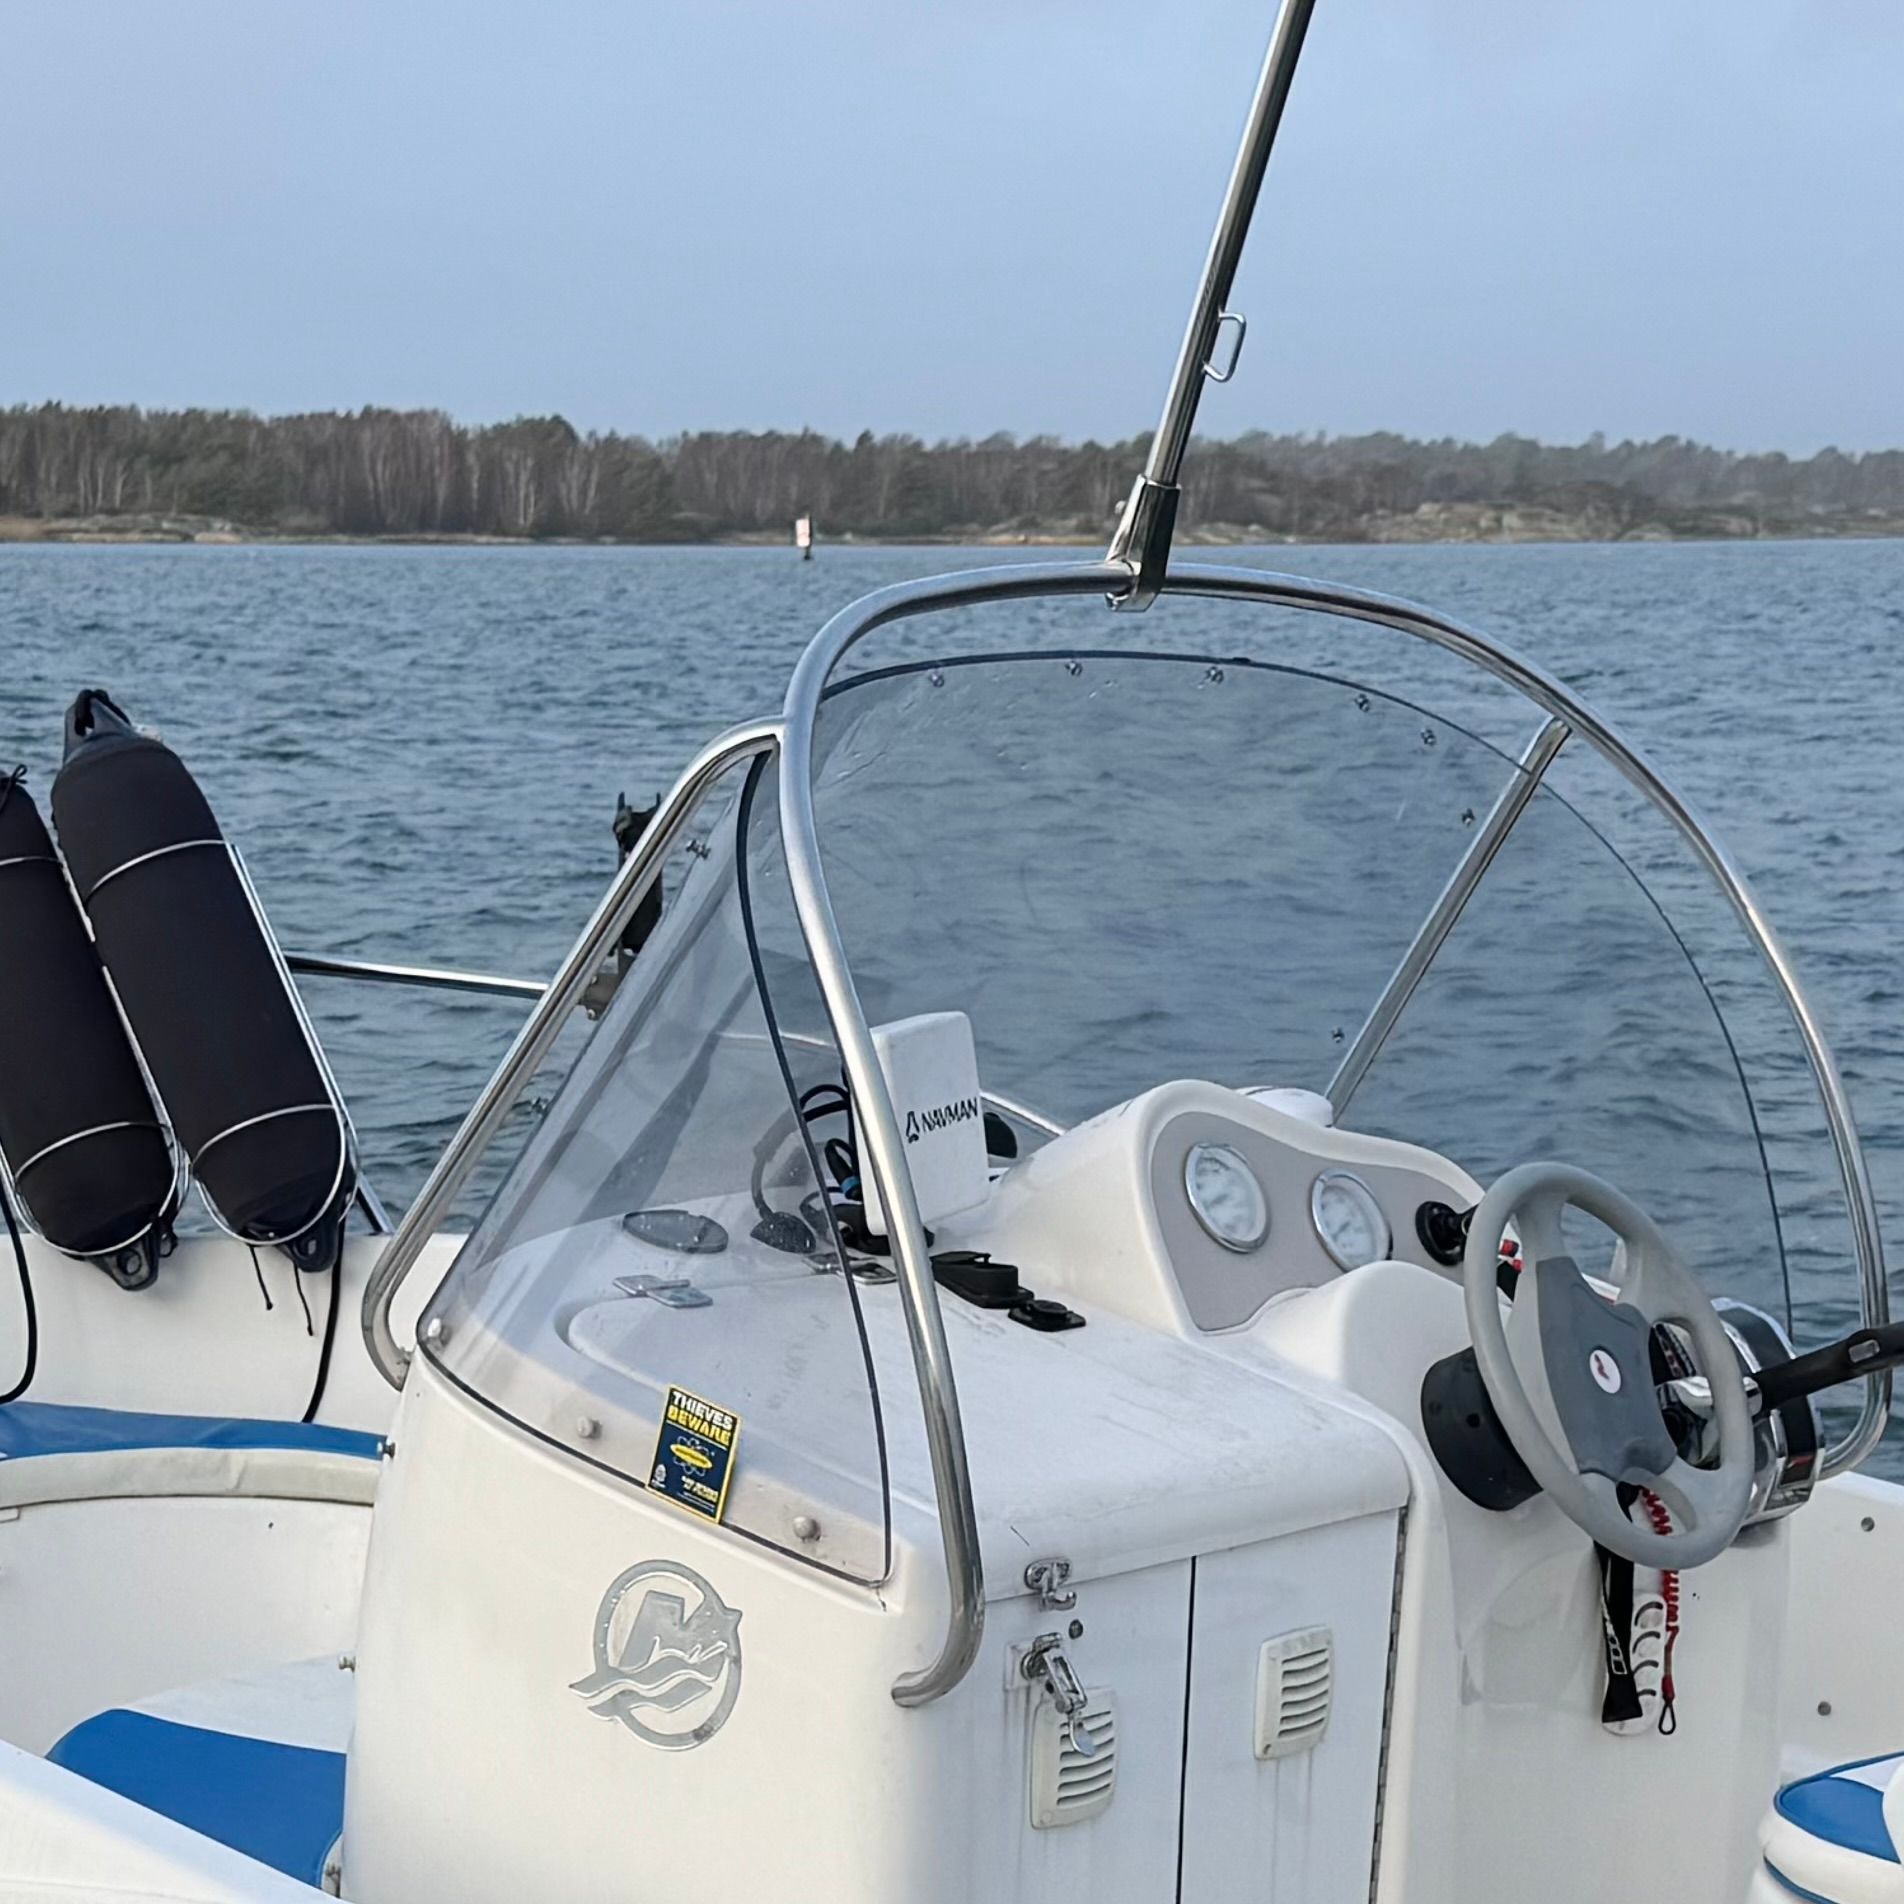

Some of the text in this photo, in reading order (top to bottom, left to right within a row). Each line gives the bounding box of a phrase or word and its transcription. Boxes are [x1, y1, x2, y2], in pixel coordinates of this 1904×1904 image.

[921, 1096, 978, 1133] NAVMAN
[667, 1404, 731, 1446] BEWARE
[673, 1391, 733, 1431] THIEVES
